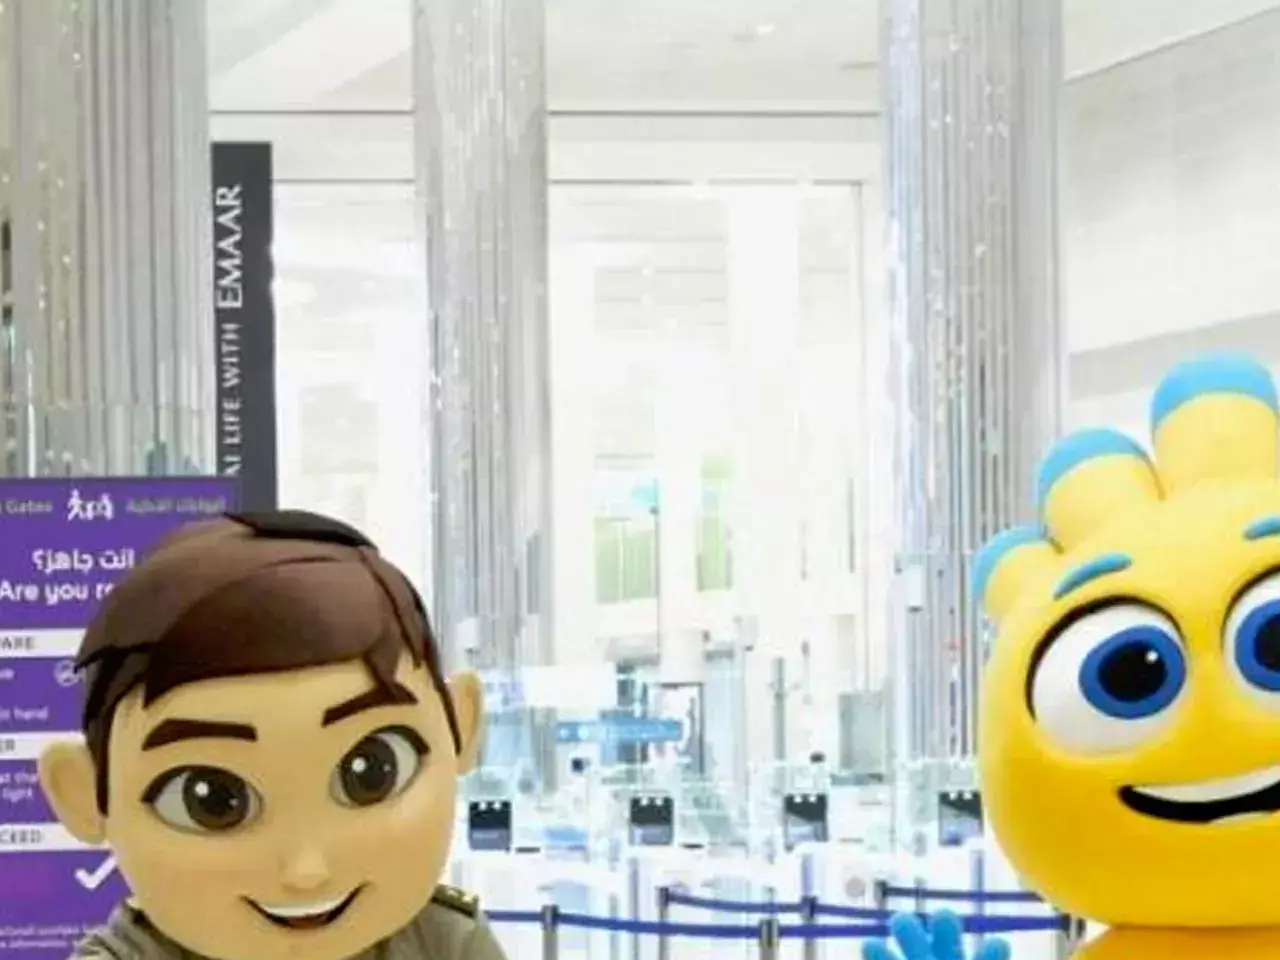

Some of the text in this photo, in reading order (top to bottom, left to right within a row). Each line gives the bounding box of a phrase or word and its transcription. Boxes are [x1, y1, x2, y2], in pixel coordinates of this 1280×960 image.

[216, 183, 243, 308] EMAAR
[221, 322, 244, 389] WITH
[221, 397, 244, 445] LIFE
[43, 582, 89, 605] you
[13, 705, 49, 720] hand
